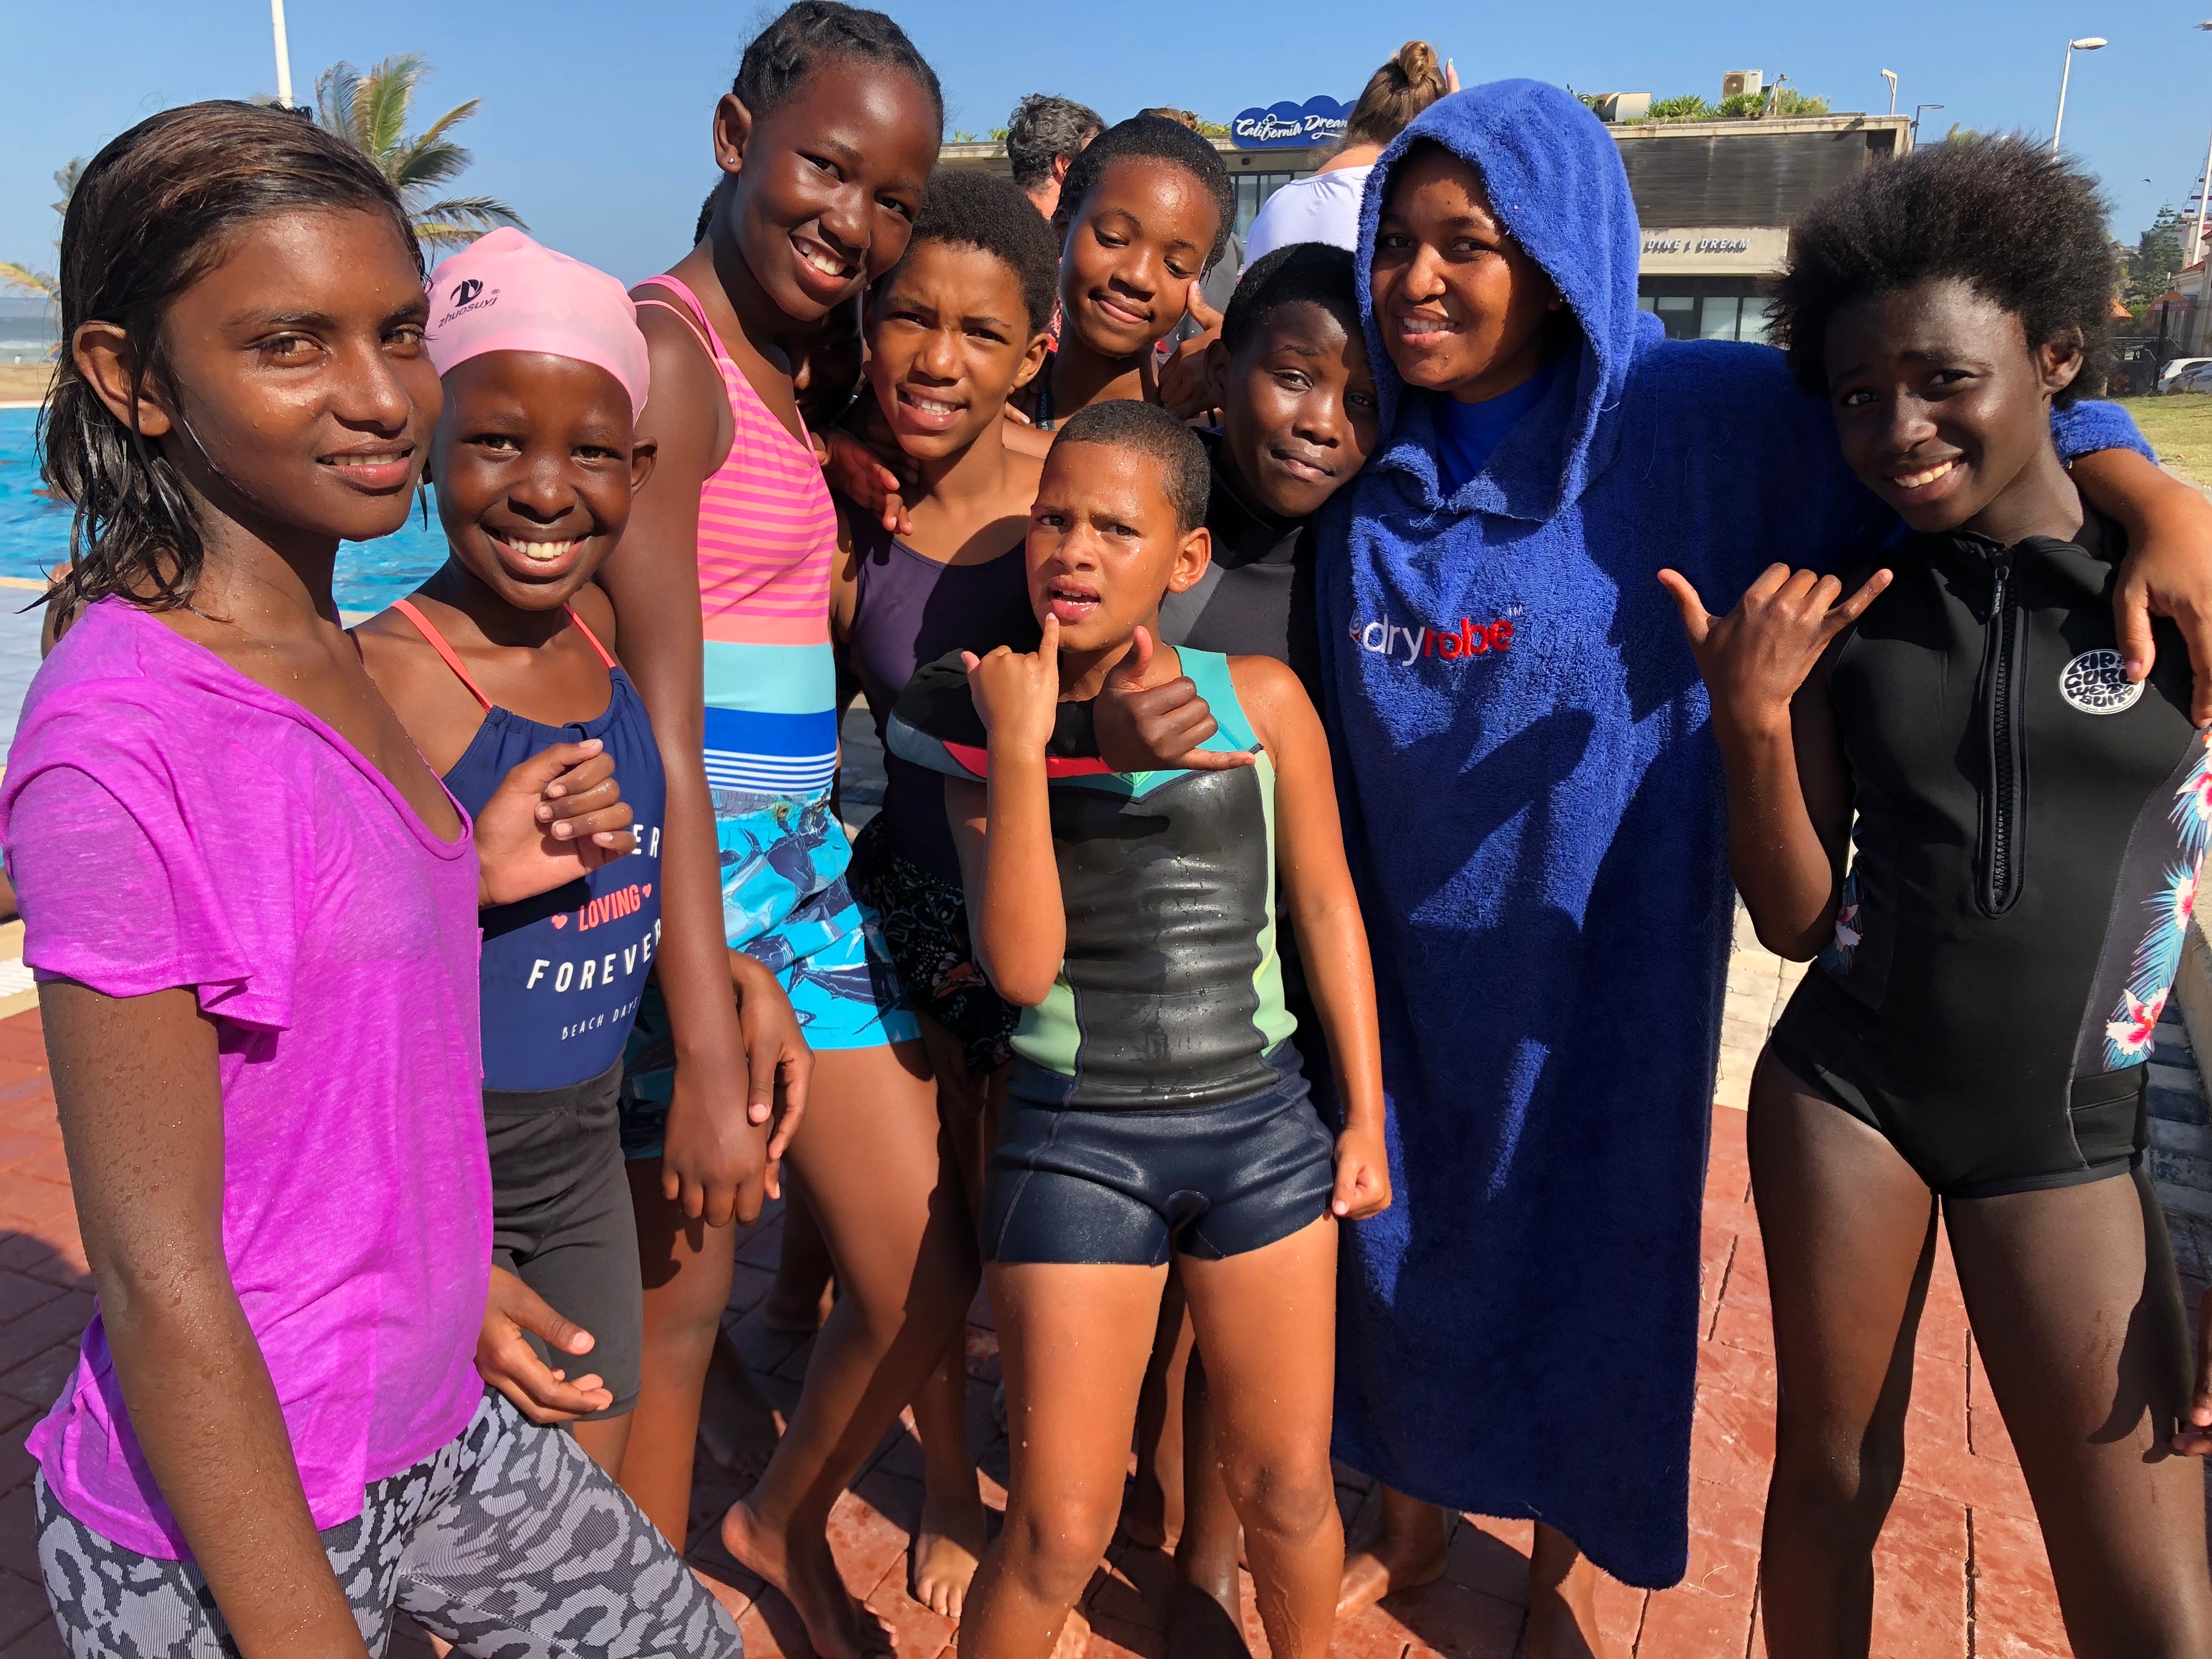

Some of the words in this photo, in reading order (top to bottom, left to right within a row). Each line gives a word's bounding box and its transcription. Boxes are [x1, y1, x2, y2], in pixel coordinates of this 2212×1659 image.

[1236, 114, 1303, 141] California
[1647, 238, 1682, 250] DINE
[1700, 238, 1751, 249] DREAM
[1362, 613, 1514, 667] dryrobe
[2067, 652, 2115, 675] RIP
[2064, 668, 2135, 689] CURL
[578, 884, 641, 932] LOVING
[526, 917, 662, 993] FOREVER
[561, 1014, 604, 1041] BEACH
